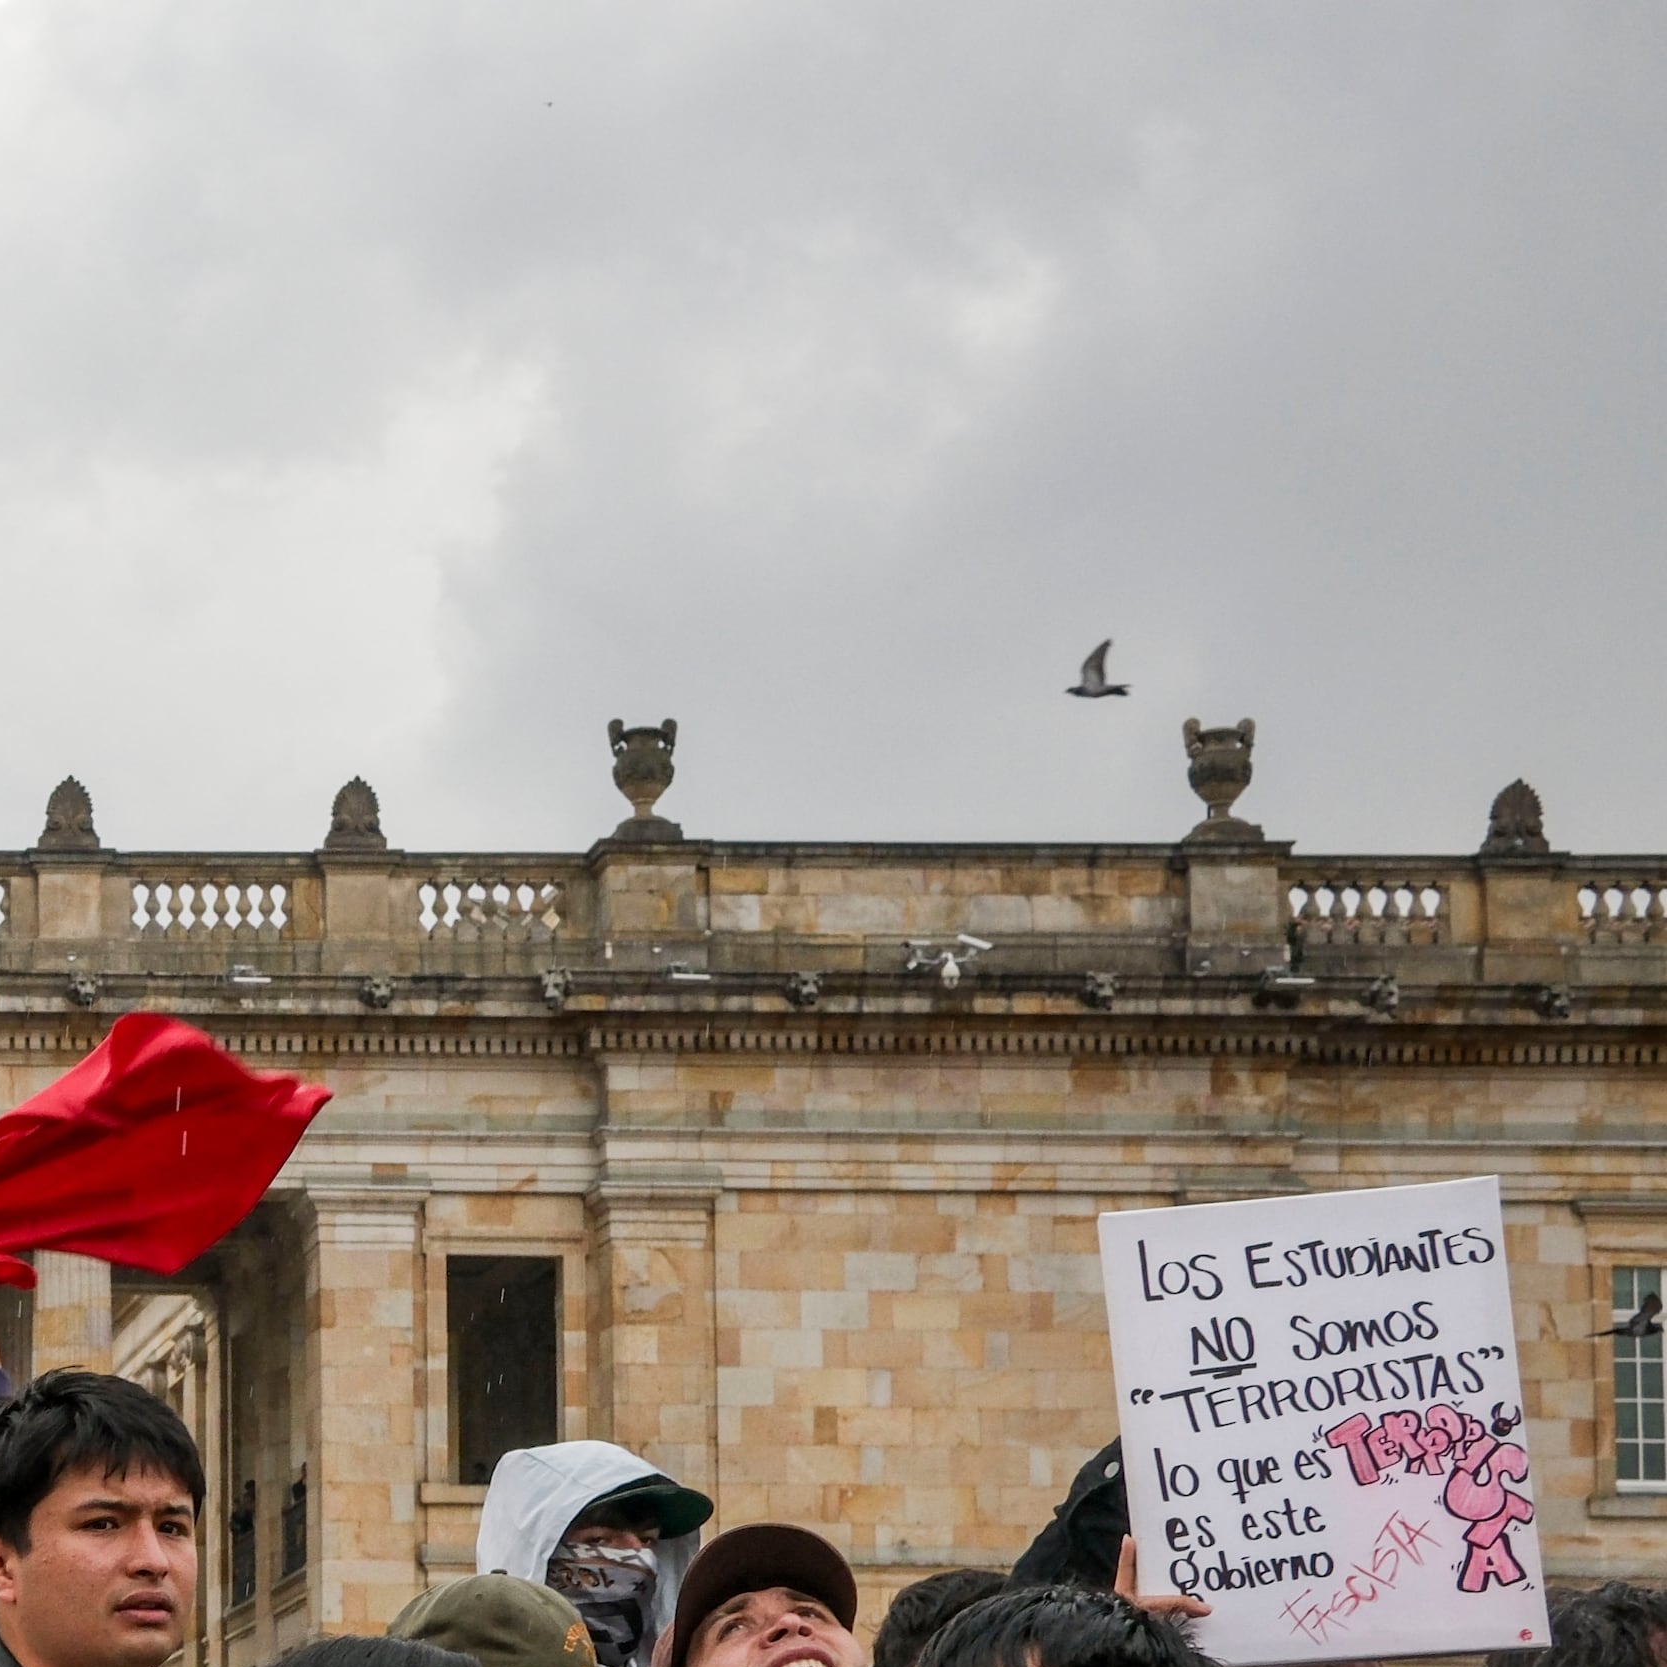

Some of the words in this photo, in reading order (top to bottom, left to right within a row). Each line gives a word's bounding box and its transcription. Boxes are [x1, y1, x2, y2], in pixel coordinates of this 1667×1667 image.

[1138, 1239, 1224, 1301] LOS
[1245, 1227, 1496, 1289] ESTUDIANTES
[1189, 1315, 1255, 1366] NO
[1153, 1447, 1199, 1502] lo
[1217, 1452, 1282, 1504] que
[1294, 1446, 1332, 1480] es
[1167, 1515, 1216, 1554] es
[1241, 1497, 1327, 1543] este
[1278, 1509, 1442, 1646] FASCISTA
